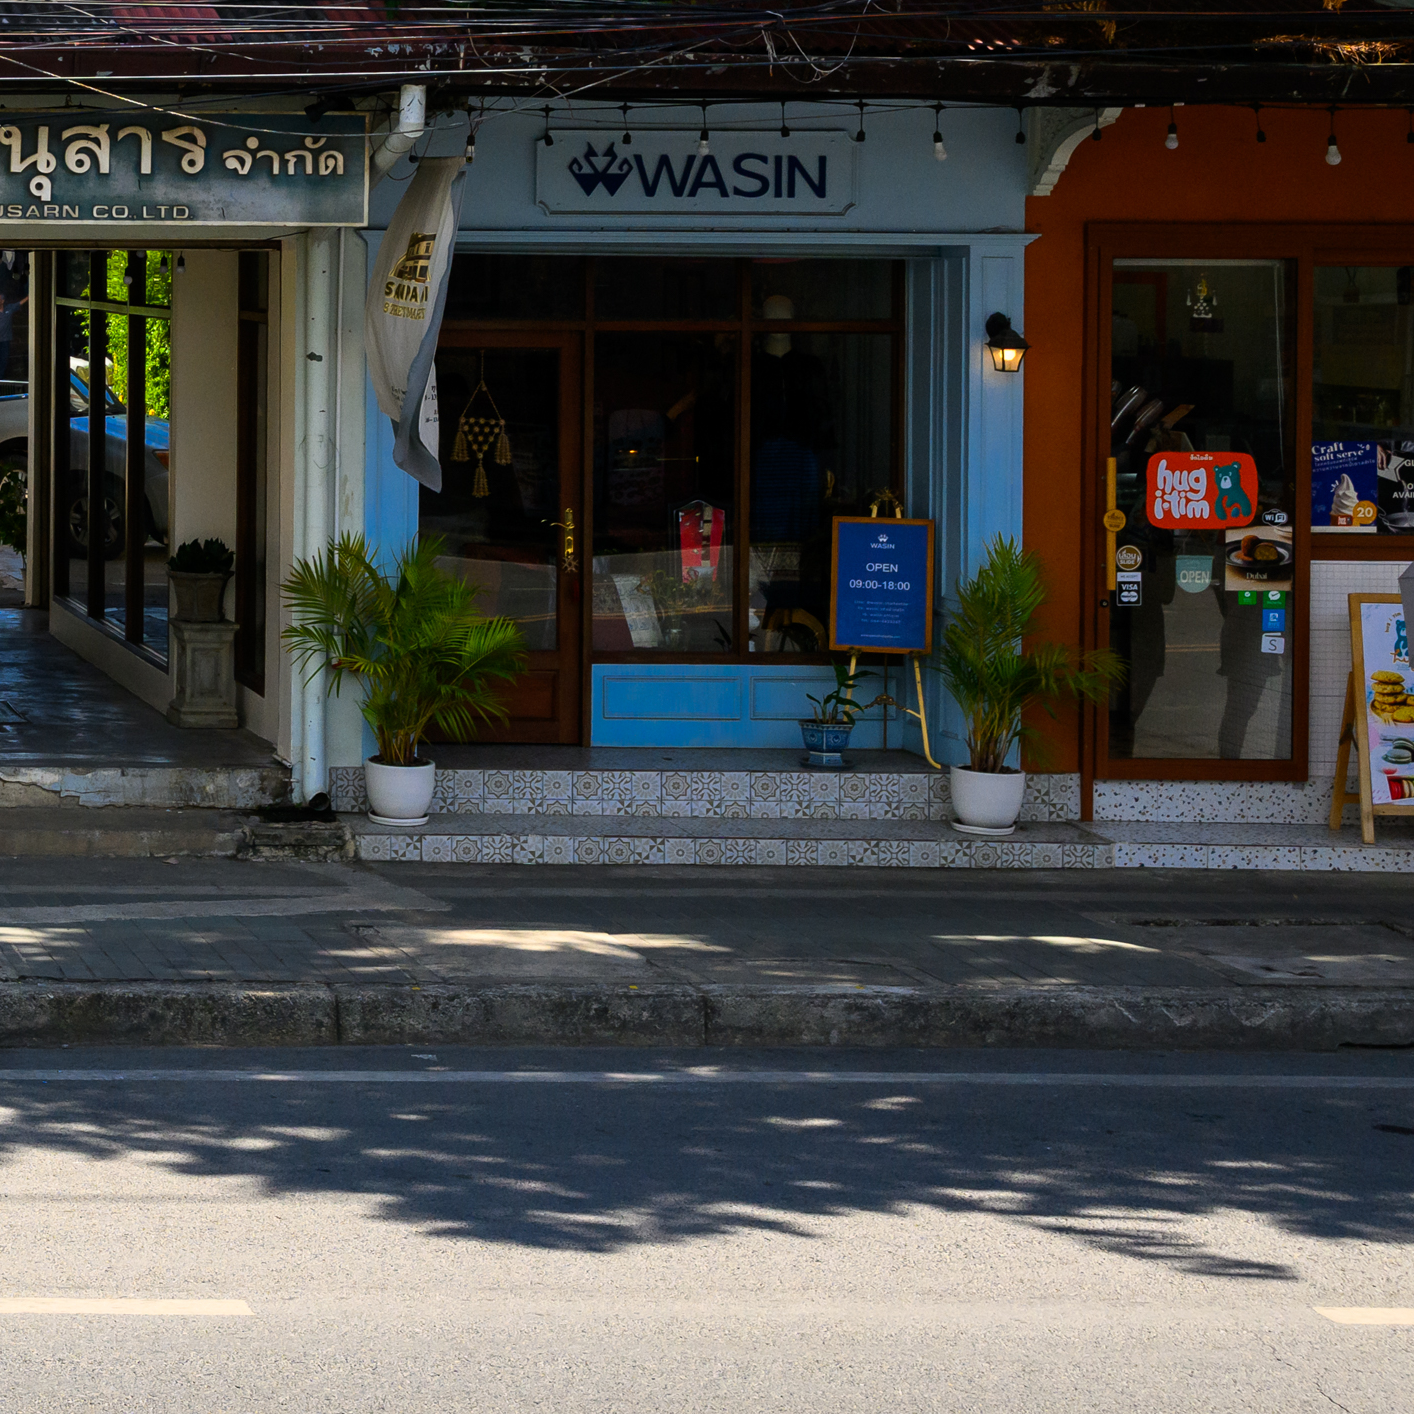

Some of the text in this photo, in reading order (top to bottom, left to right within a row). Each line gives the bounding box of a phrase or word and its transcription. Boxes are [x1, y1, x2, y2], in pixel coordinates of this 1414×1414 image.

[222, 136, 345, 176] จำกัด
[633, 153, 828, 199] WASIN
[1311, 441, 1344, 455] Craft
[1314, 450, 1365, 463] soft serve
[1156, 458, 1208, 501] hug
[1356, 506, 1374, 518] 20
[870, 542, 896, 550] WASIN
[865, 562, 899, 573] OPEN
[1180, 570, 1210, 584] OPEN
[849, 579, 911, 591] 09:00-18:00
